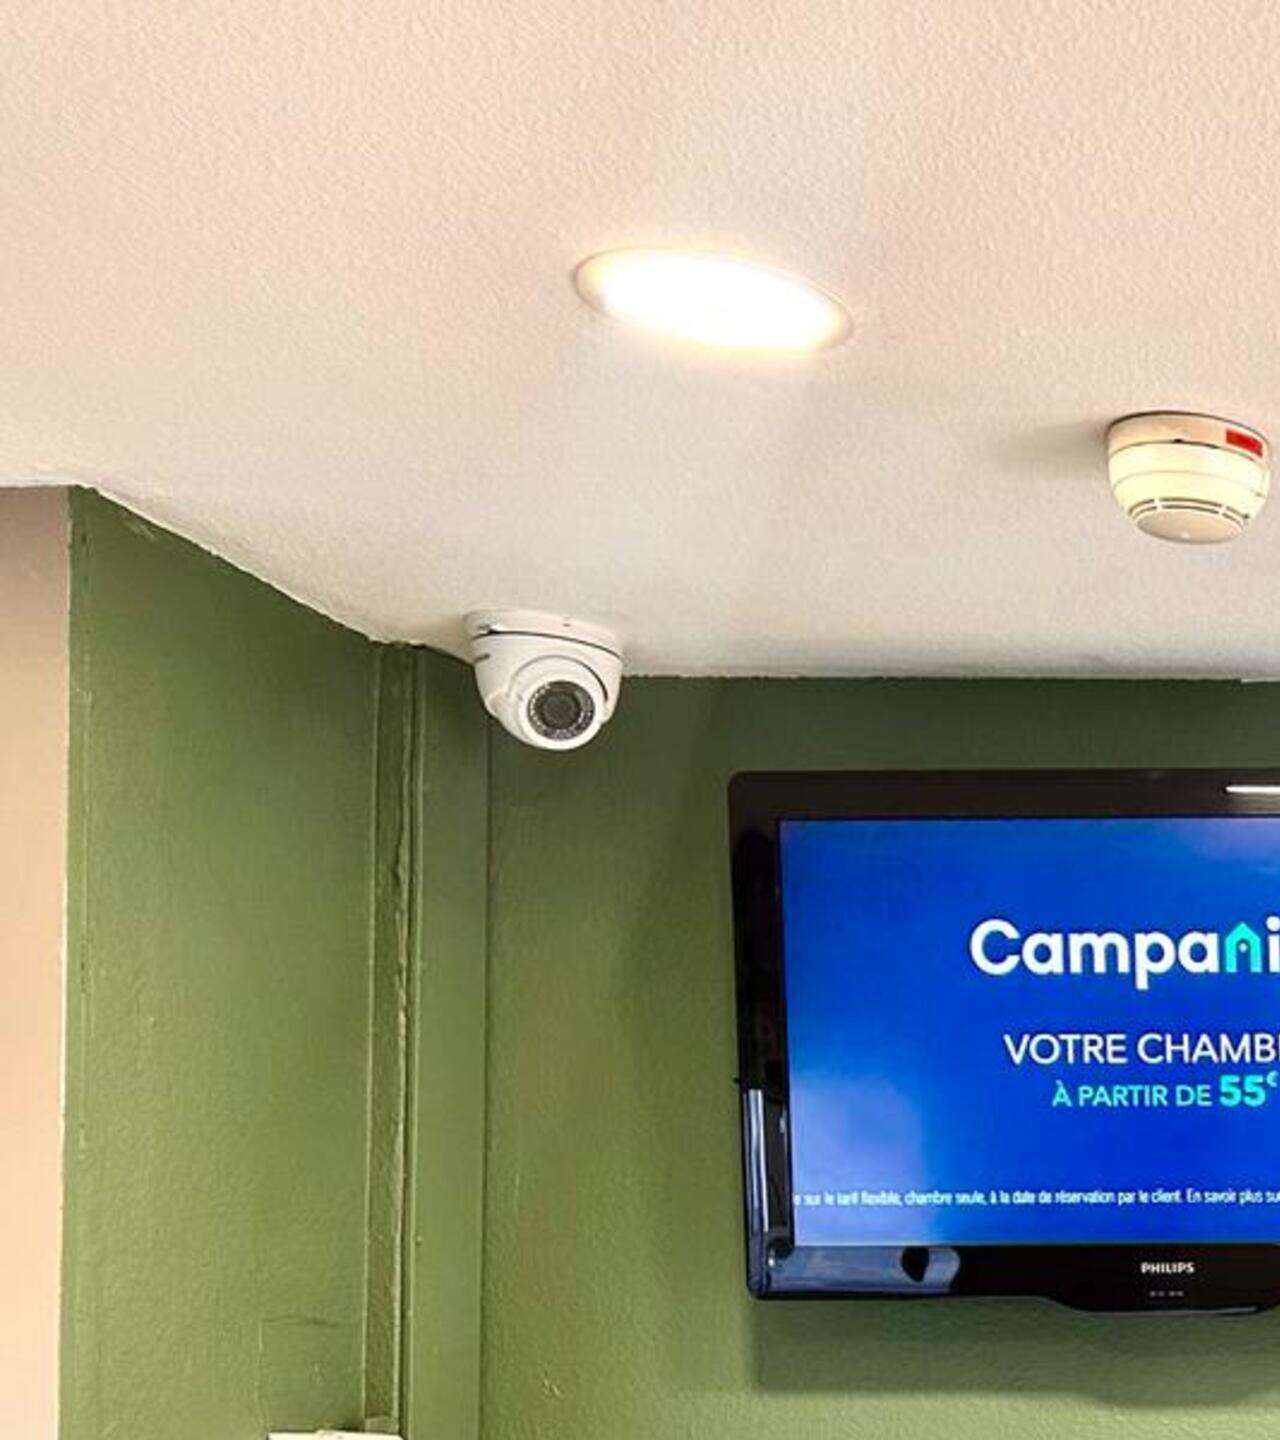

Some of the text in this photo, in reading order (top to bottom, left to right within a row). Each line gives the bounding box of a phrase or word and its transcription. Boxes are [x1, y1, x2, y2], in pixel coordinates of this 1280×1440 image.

[1002, 1033, 1129, 1065] VOTRE
[1051, 1079, 1073, 1108] À
[1077, 1084, 1168, 1107] PARTIR
[1175, 1084, 1213, 1107] DE
[904, 1189, 953, 1206] chambre
[999, 1189, 1011, 1204] la
[1012, 1189, 1036, 1205] date
[1039, 1189, 1052, 1204] de
[1055, 1189, 1117, 1204] réservation
[1118, 1191, 1136, 1206] par
[1138, 1189, 1149, 1204] le
[1185, 1187, 1201, 1204] En
[1204, 1187, 1237, 1204] savoir
[1239, 1189, 1263, 1206] plus
[1141, 1261, 1196, 1275] PHILIPS
